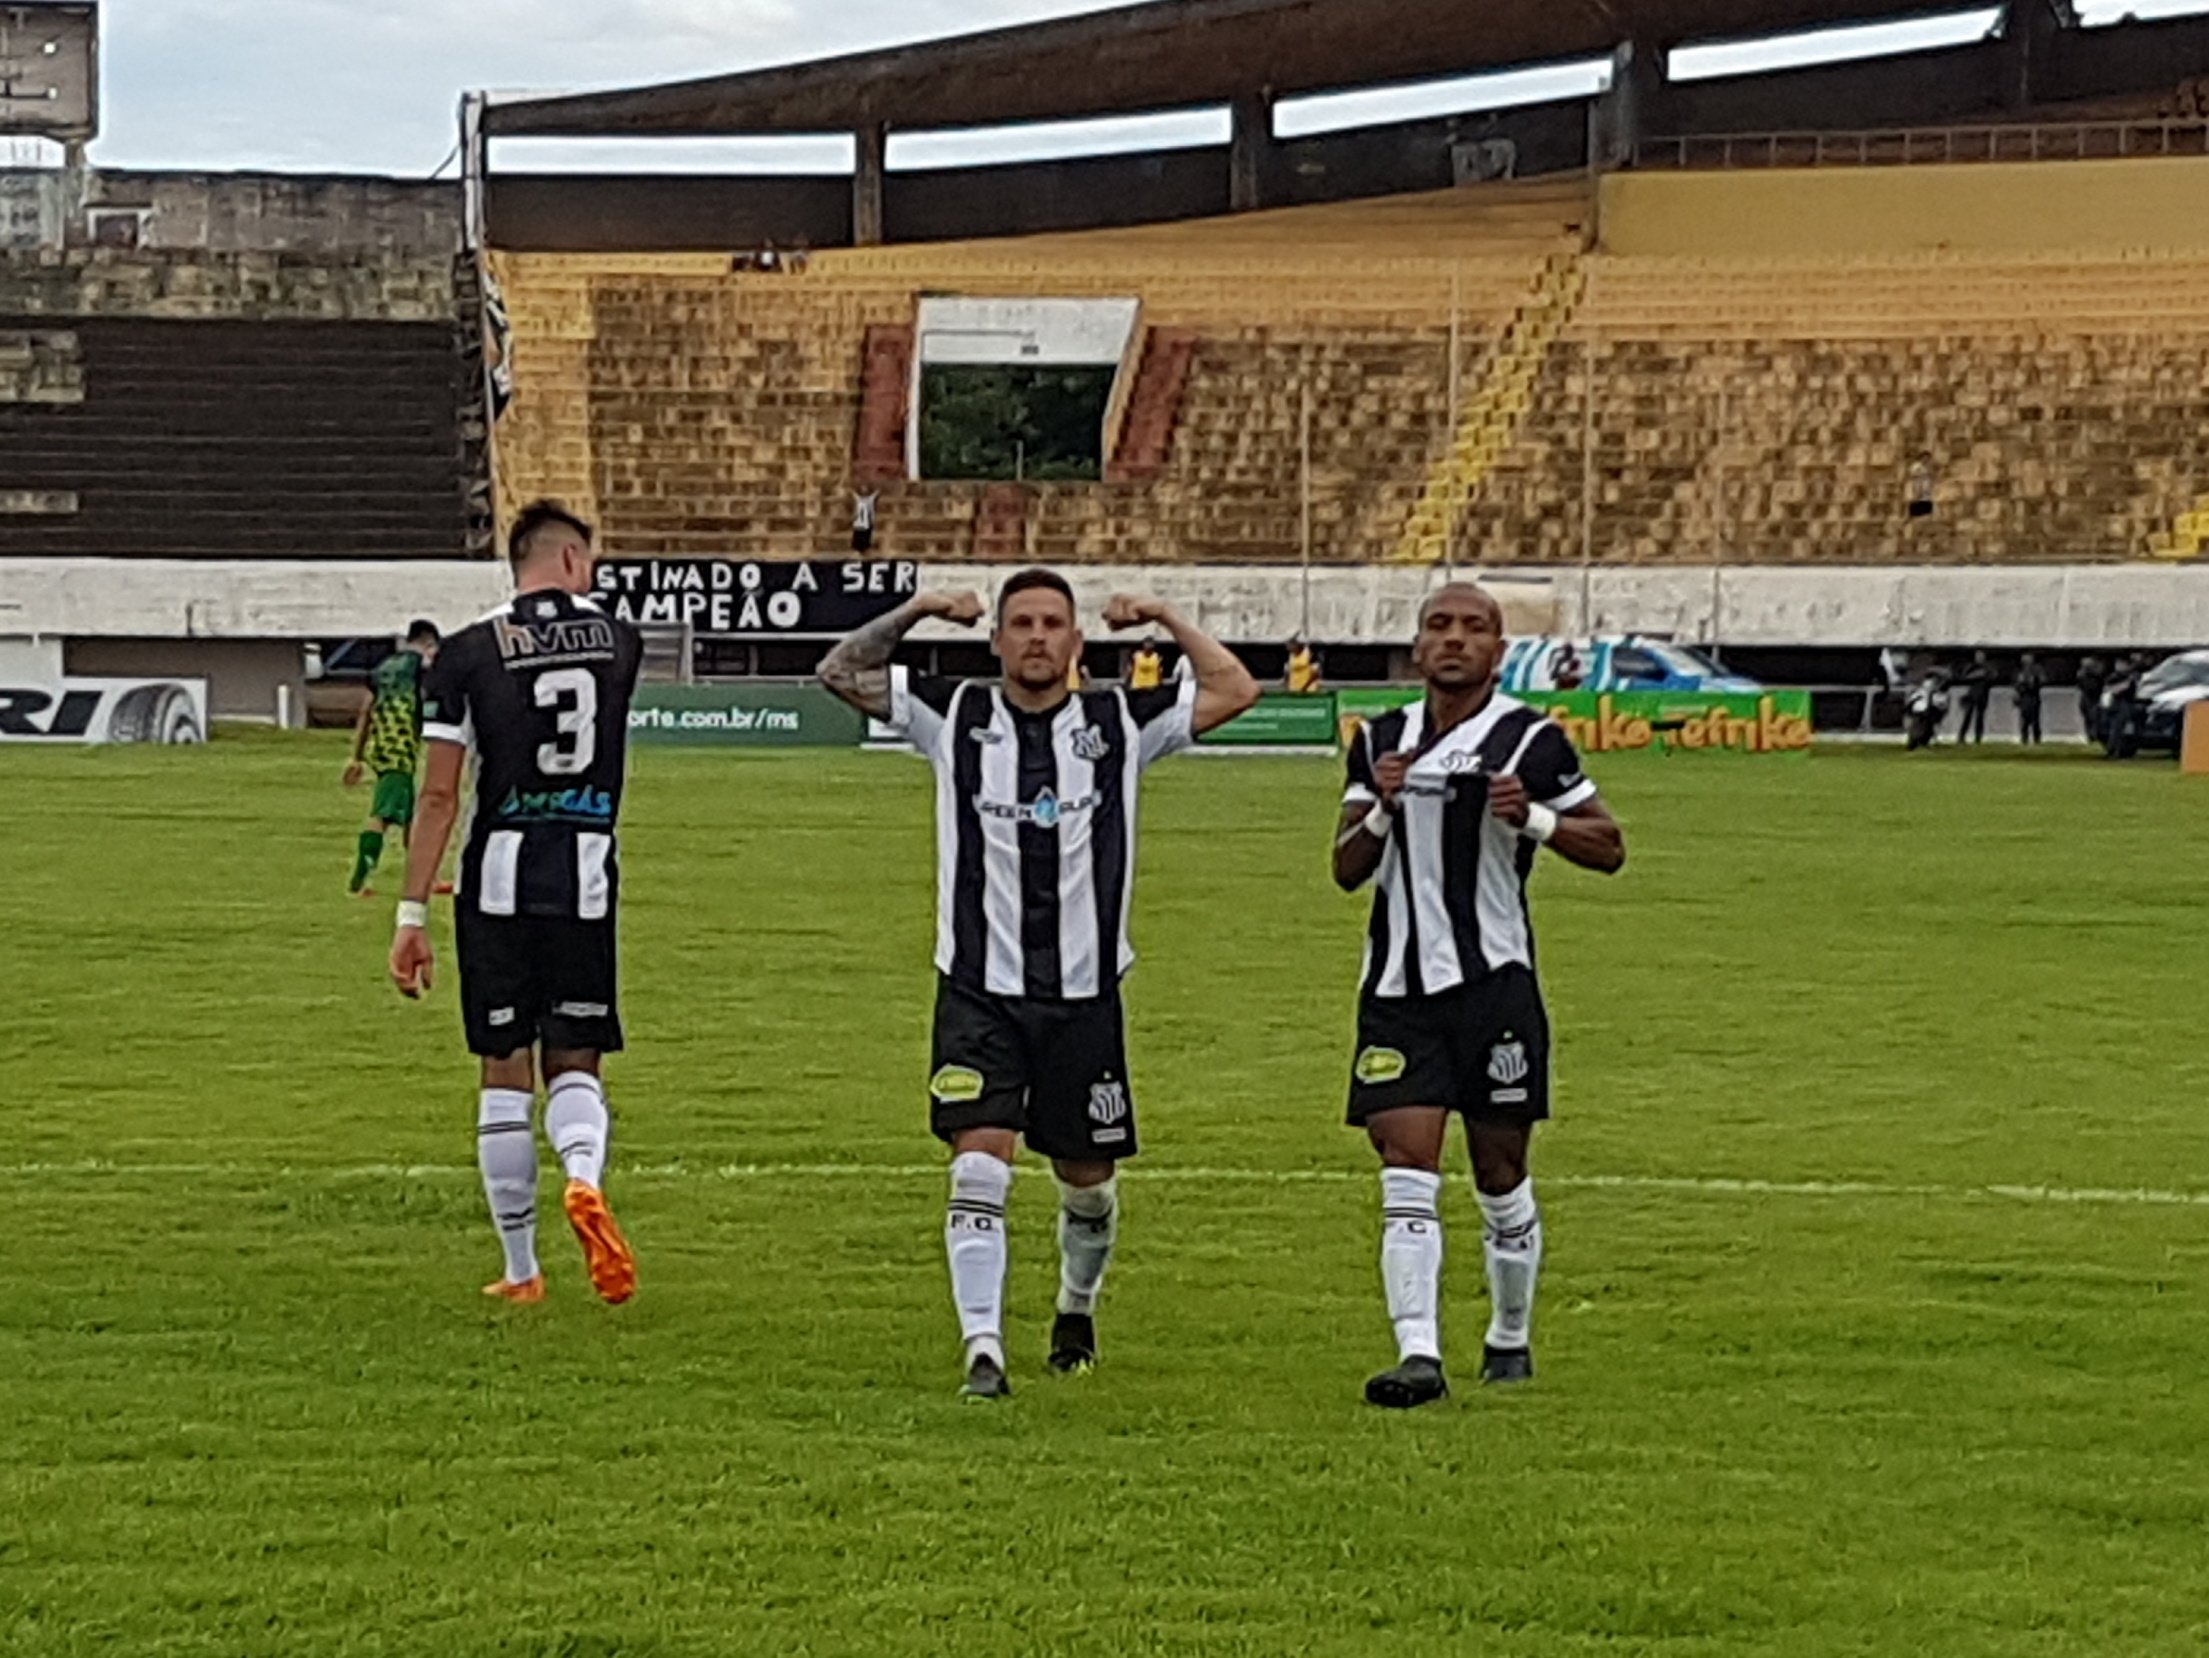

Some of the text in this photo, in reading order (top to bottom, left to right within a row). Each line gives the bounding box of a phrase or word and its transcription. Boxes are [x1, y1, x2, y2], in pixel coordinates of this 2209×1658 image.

[597, 562, 915, 592] STINADO A SER
[534, 667, 597, 774] 3
[628, 706, 799, 730] orte.com.br/ms
